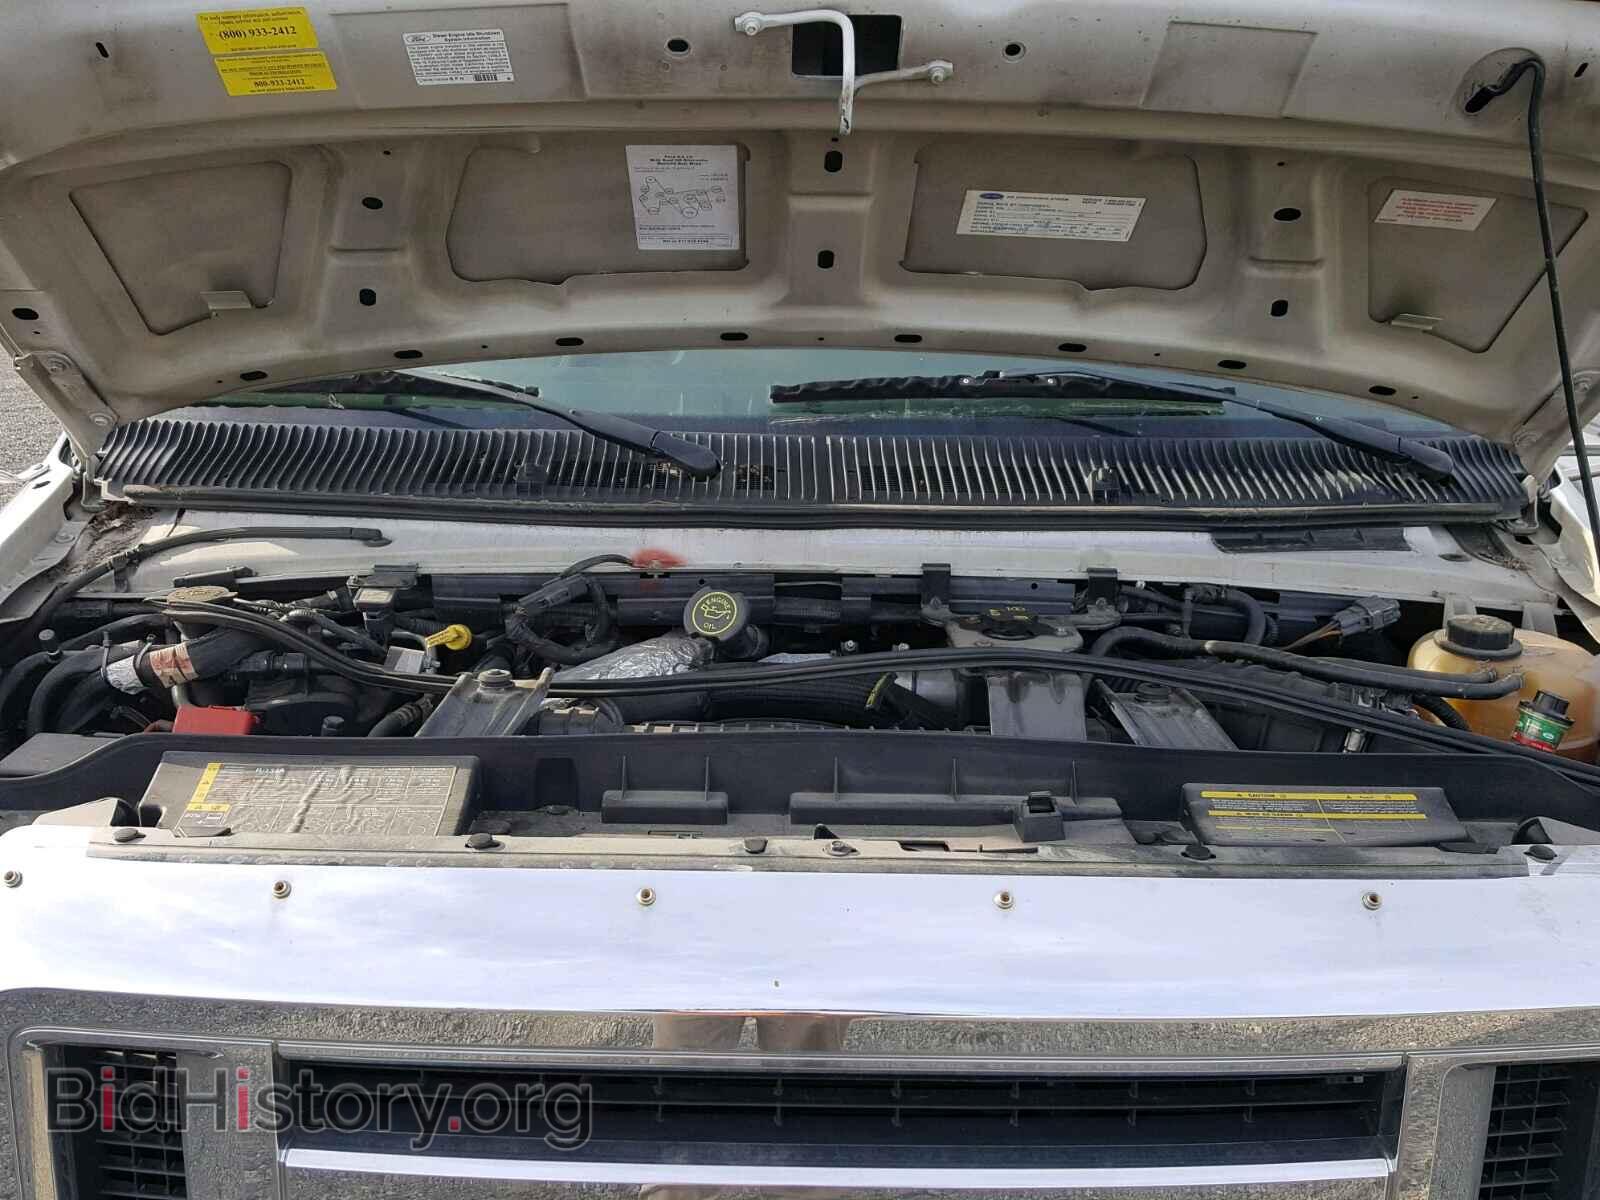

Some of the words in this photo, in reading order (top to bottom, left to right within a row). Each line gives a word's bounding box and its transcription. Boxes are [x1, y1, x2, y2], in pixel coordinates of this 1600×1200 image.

[219, 29, 247, 40] (800)
[248, 25, 297, 37] 933-2412
[254, 79, 306, 88] 800-933-2412
[704, 622, 717, 631] OIL
